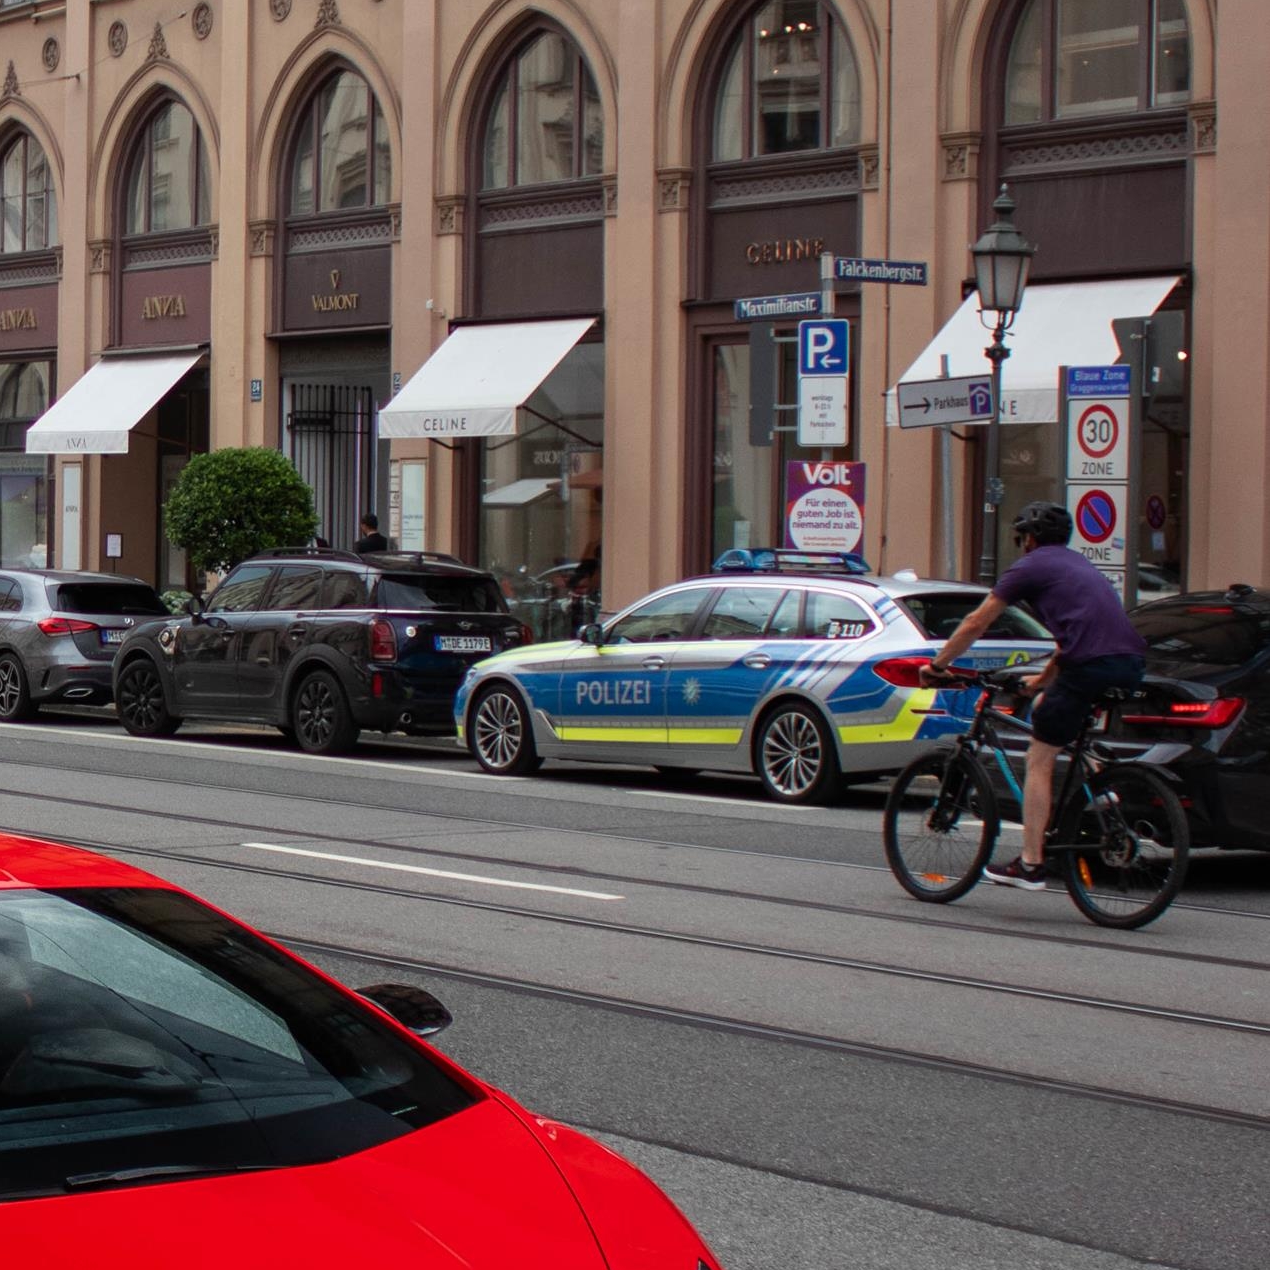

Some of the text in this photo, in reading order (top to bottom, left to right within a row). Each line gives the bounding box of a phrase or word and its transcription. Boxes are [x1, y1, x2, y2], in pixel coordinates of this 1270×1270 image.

[746, 237, 824, 265] CELINE
[839, 260, 923, 282] Falckenbergstr.
[312, 293, 359, 311] VALMONT
[740, 296, 817, 318] Maximilianstr.
[807, 327, 834, 369] P
[1102, 369, 1126, 380] Zone
[934, 396, 969, 411] Parkhaus
[423, 417, 467, 432] CELINE
[1086, 419, 1110, 443] 30
[802, 463, 852, 485] Volt
[1081, 461, 1114, 475] ZONE
[805, 498, 847, 507] Für einen
[796, 509, 855, 519] guten Job ist
[792, 520, 860, 530] niemand zu alt.
[840, 623, 864, 637] 110
[972, 657, 1005, 669] POLIZEI
[576, 680, 651, 706] POLIZEI
